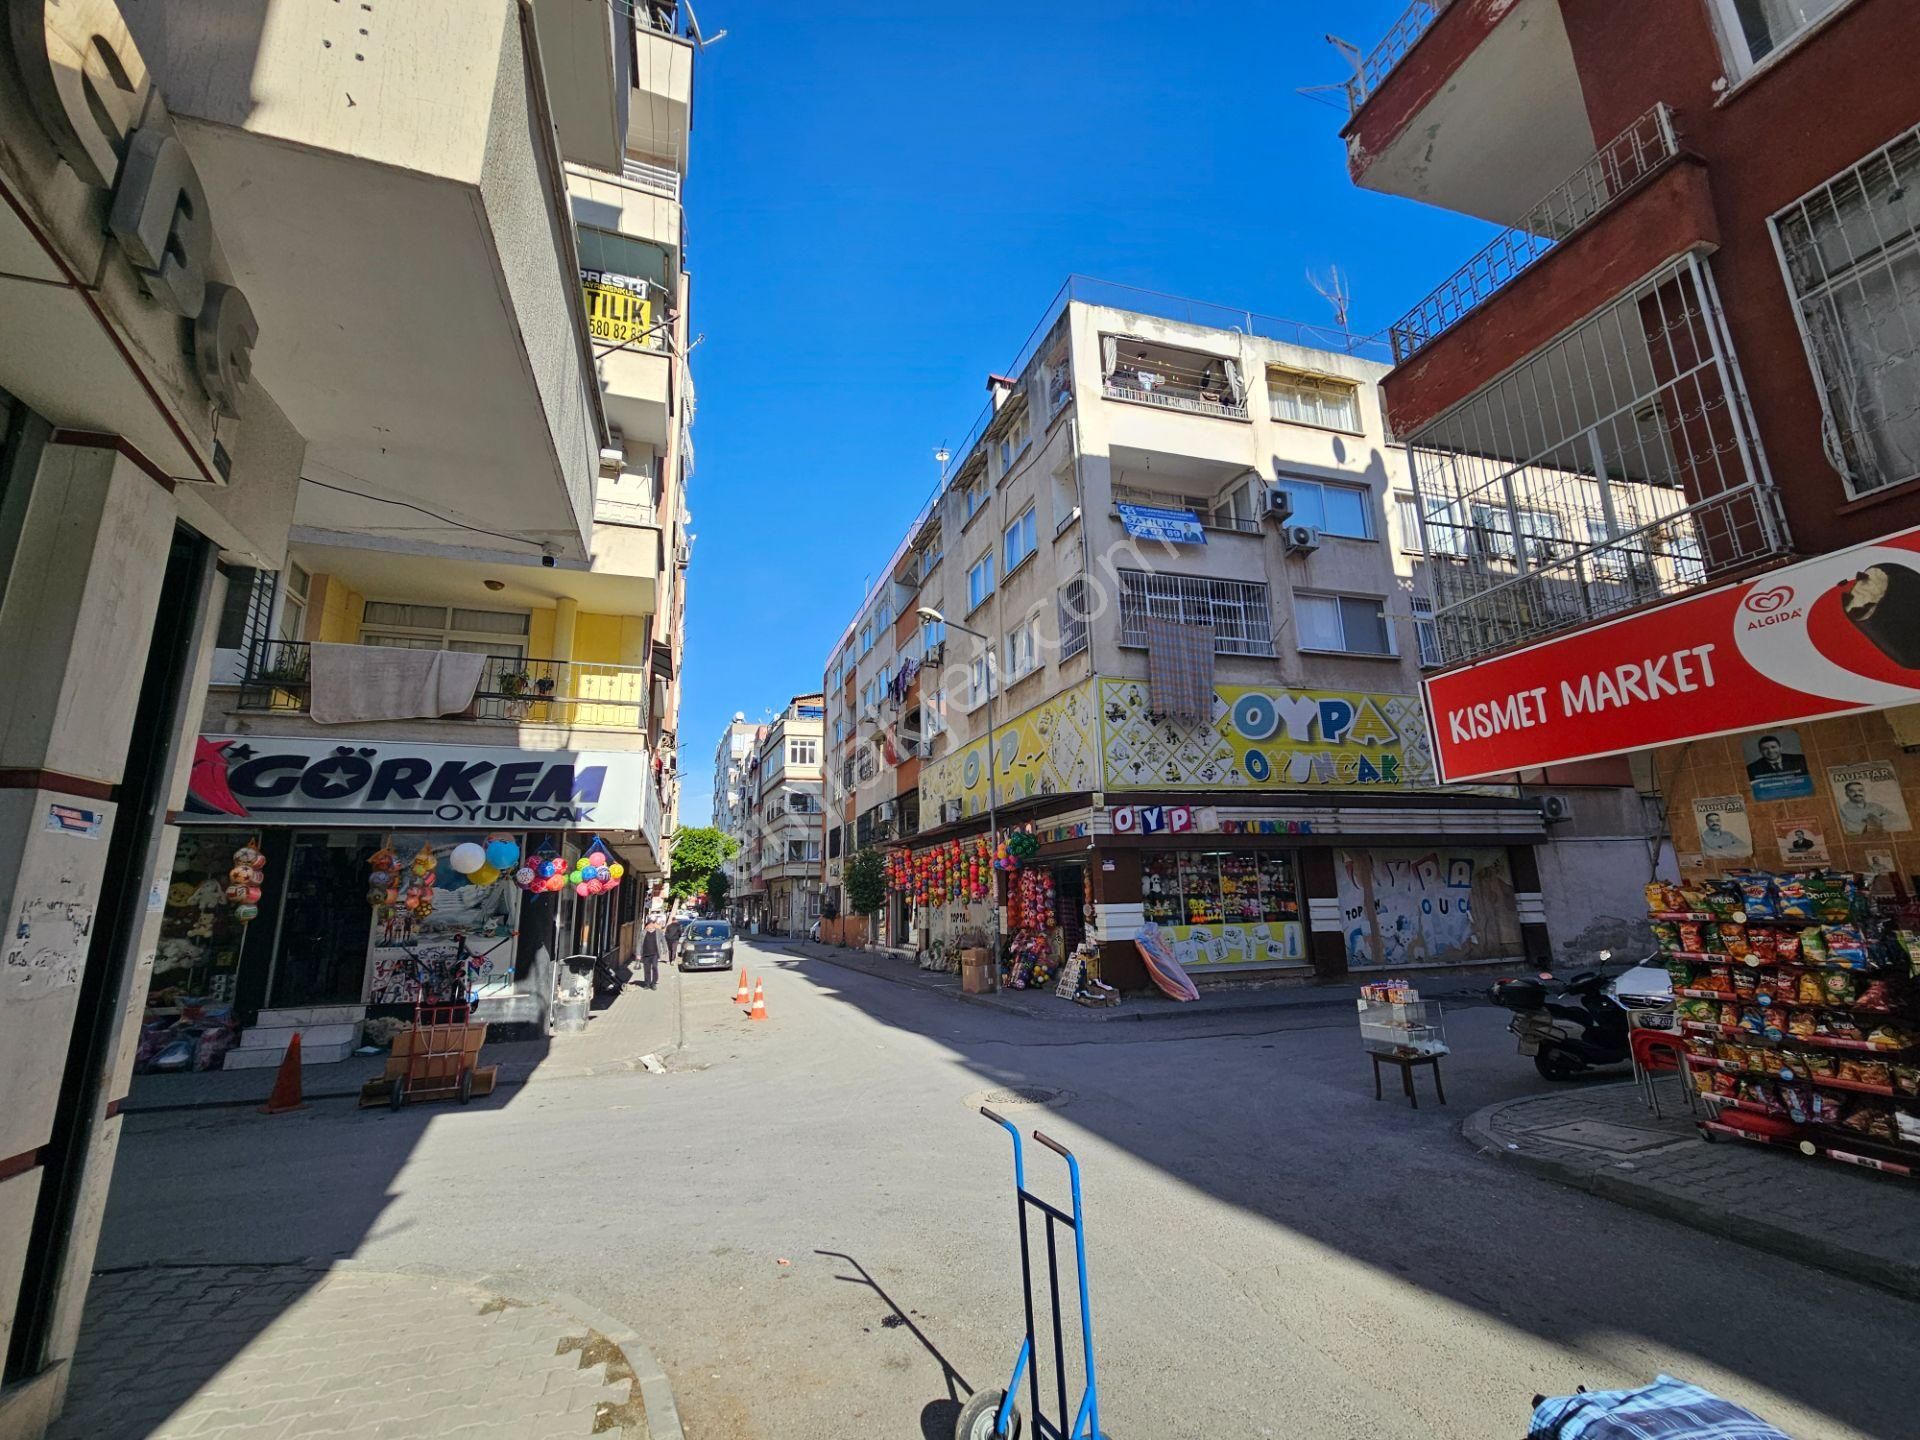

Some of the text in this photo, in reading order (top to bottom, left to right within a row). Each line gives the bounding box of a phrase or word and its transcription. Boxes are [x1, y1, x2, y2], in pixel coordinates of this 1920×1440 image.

[613, 323, 627, 341] 82
[1126, 515, 1175, 530] SATILIK
[1747, 610, 1799, 631] ALGIDA
[1449, 643, 1716, 744] KISMET MARKET
[1231, 692, 1399, 746] OYPA
[228, 745, 609, 804] GÖRKEM
[1243, 748, 1401, 785] OYUNCAK
[1832, 767, 1890, 783] MUHTAR
[434, 803, 596, 823] OYUNCAK
[1696, 801, 1743, 814] MUHTAR
[1112, 804, 1216, 835] OYPA
[1659, 1016, 1674, 1025] 207
